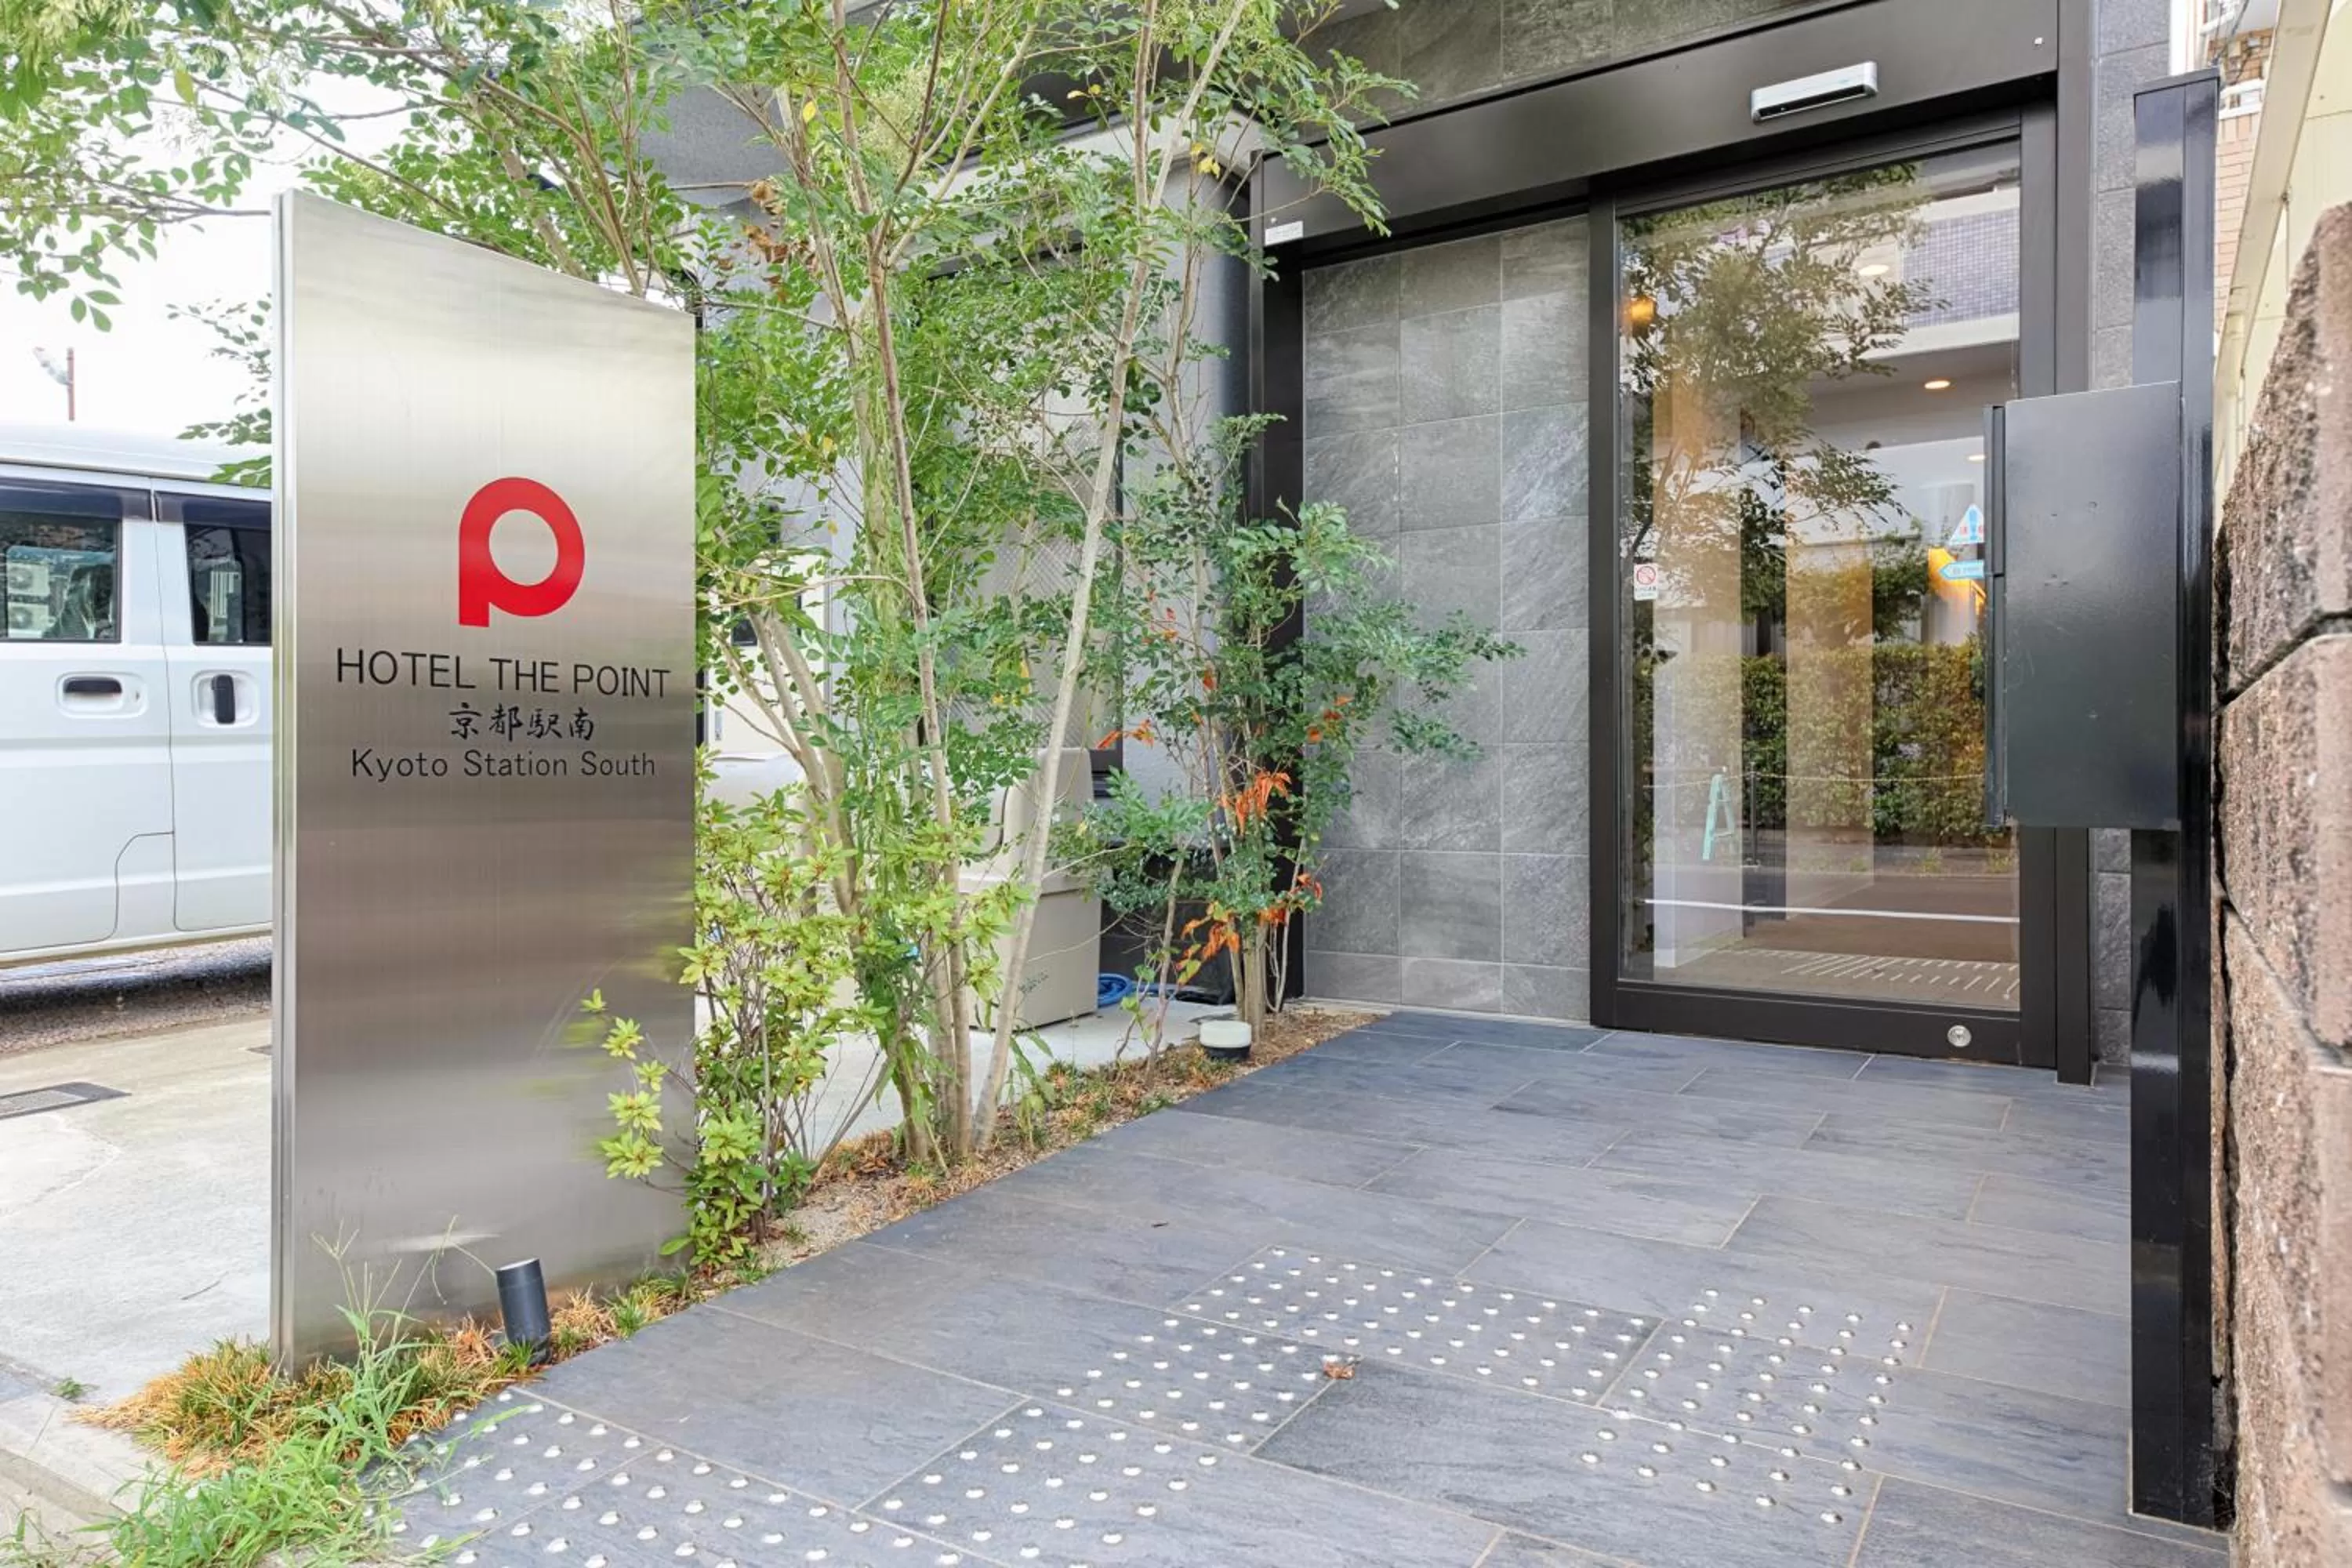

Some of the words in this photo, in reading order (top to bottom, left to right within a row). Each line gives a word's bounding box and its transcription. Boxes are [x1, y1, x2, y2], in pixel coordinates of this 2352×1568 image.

[336, 647, 477, 689] HOTEL
[488, 657, 560, 693] THE
[573, 663, 672, 698] POINT
[448, 702, 595, 742] 京都駅南
[352, 749, 448, 782] Kyoto
[463, 749, 567, 777] Station
[581, 750, 655, 776] South
